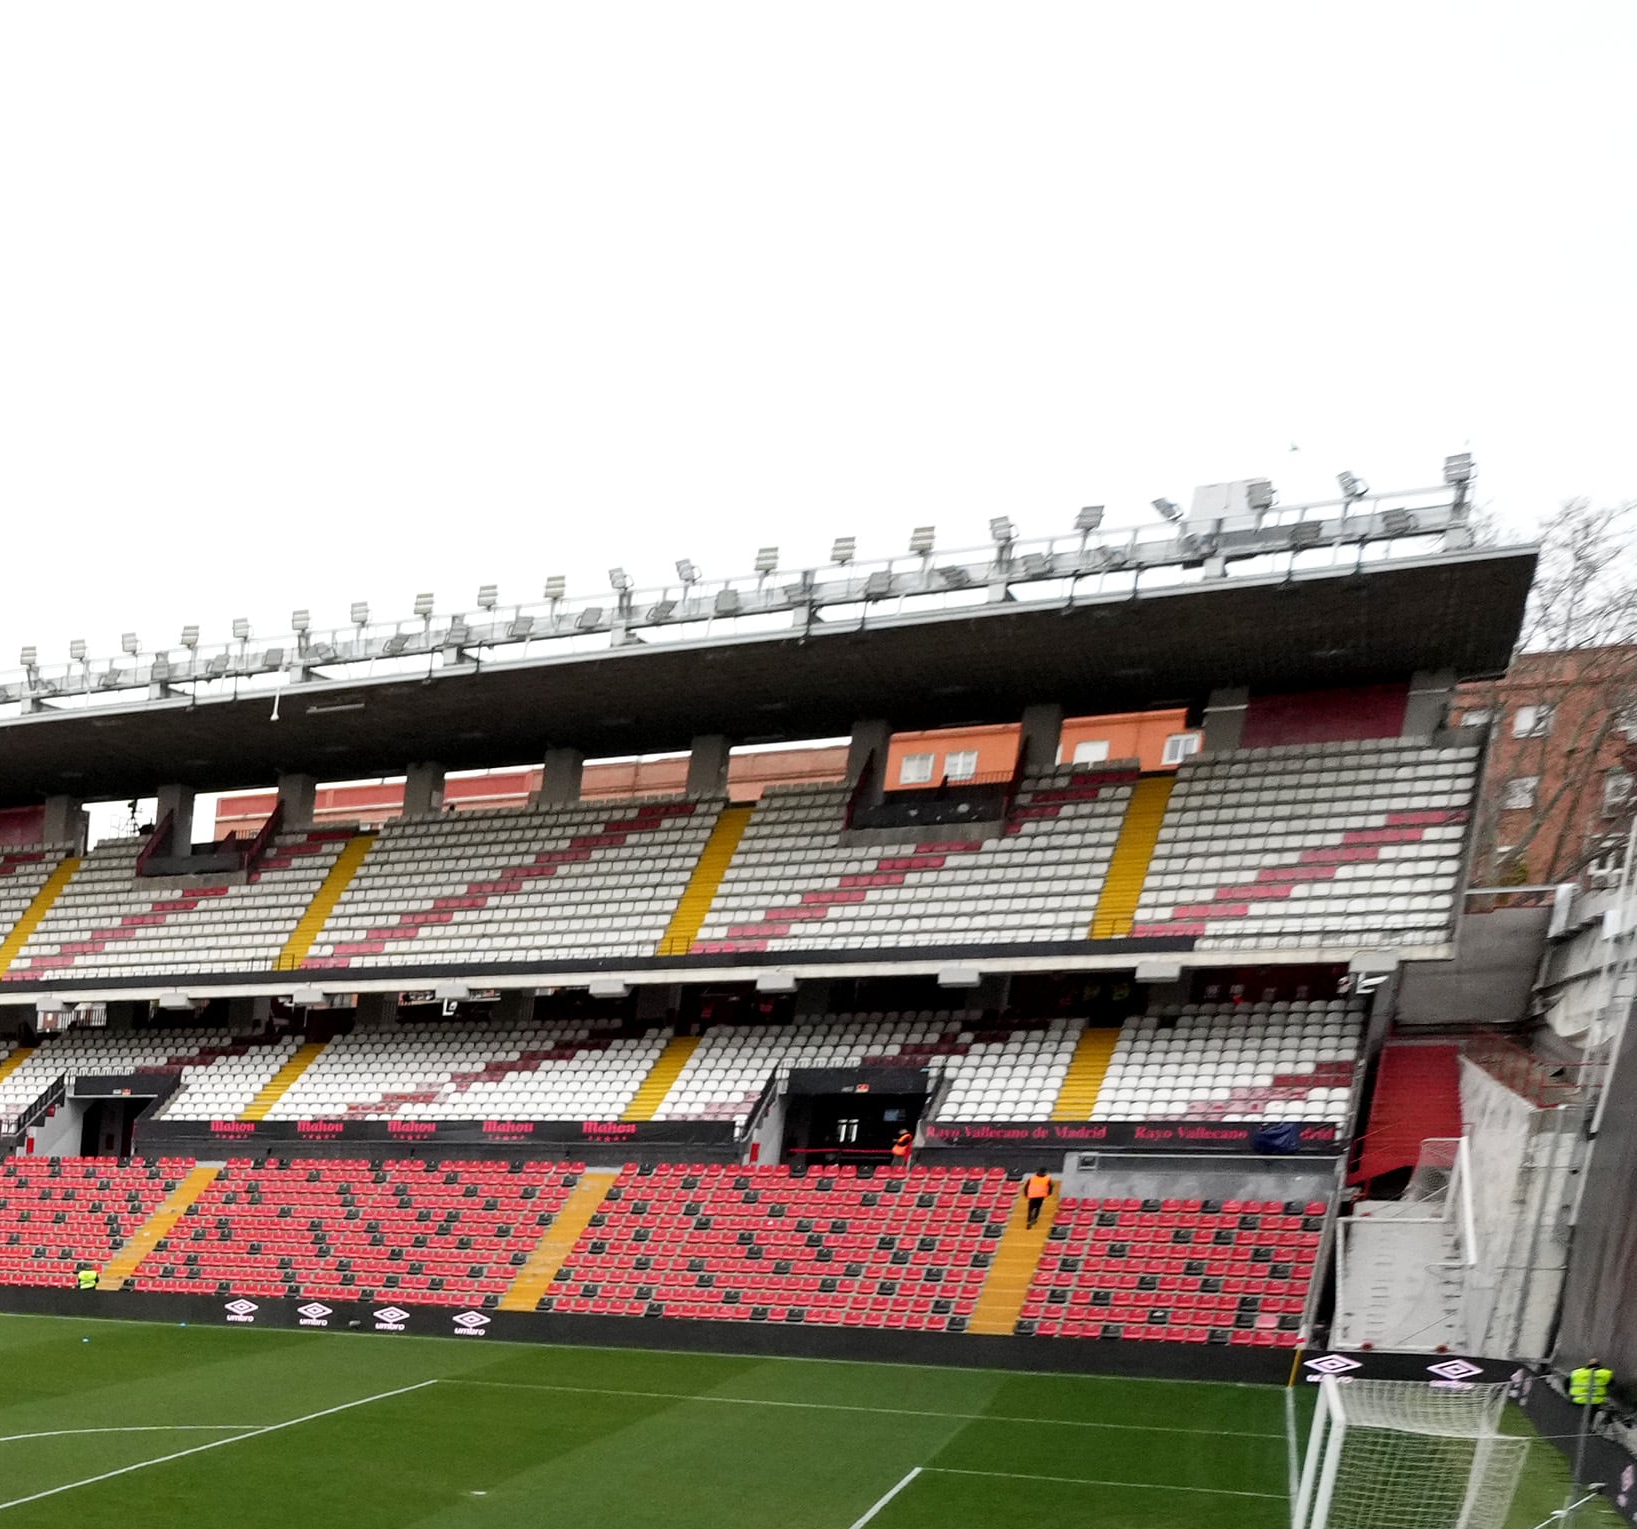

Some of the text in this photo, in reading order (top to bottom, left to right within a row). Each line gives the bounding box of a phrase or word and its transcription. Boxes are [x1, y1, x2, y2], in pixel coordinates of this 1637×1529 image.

[211, 1120, 255, 1131] Mahou
[297, 1120, 343, 1132] Mahou
[388, 1121, 436, 1132] Mahou
[482, 1121, 533, 1132] Mahou
[582, 1121, 636, 1133] Mahou
[926, 1126, 1107, 1140] Rayo Vallecano de Madrid
[1134, 1126, 1174, 1141] Rayo
[1178, 1126, 1248, 1140] Vallecano
[300, 1318, 328, 1326] umbro
[375, 1322, 405, 1331] umbro
